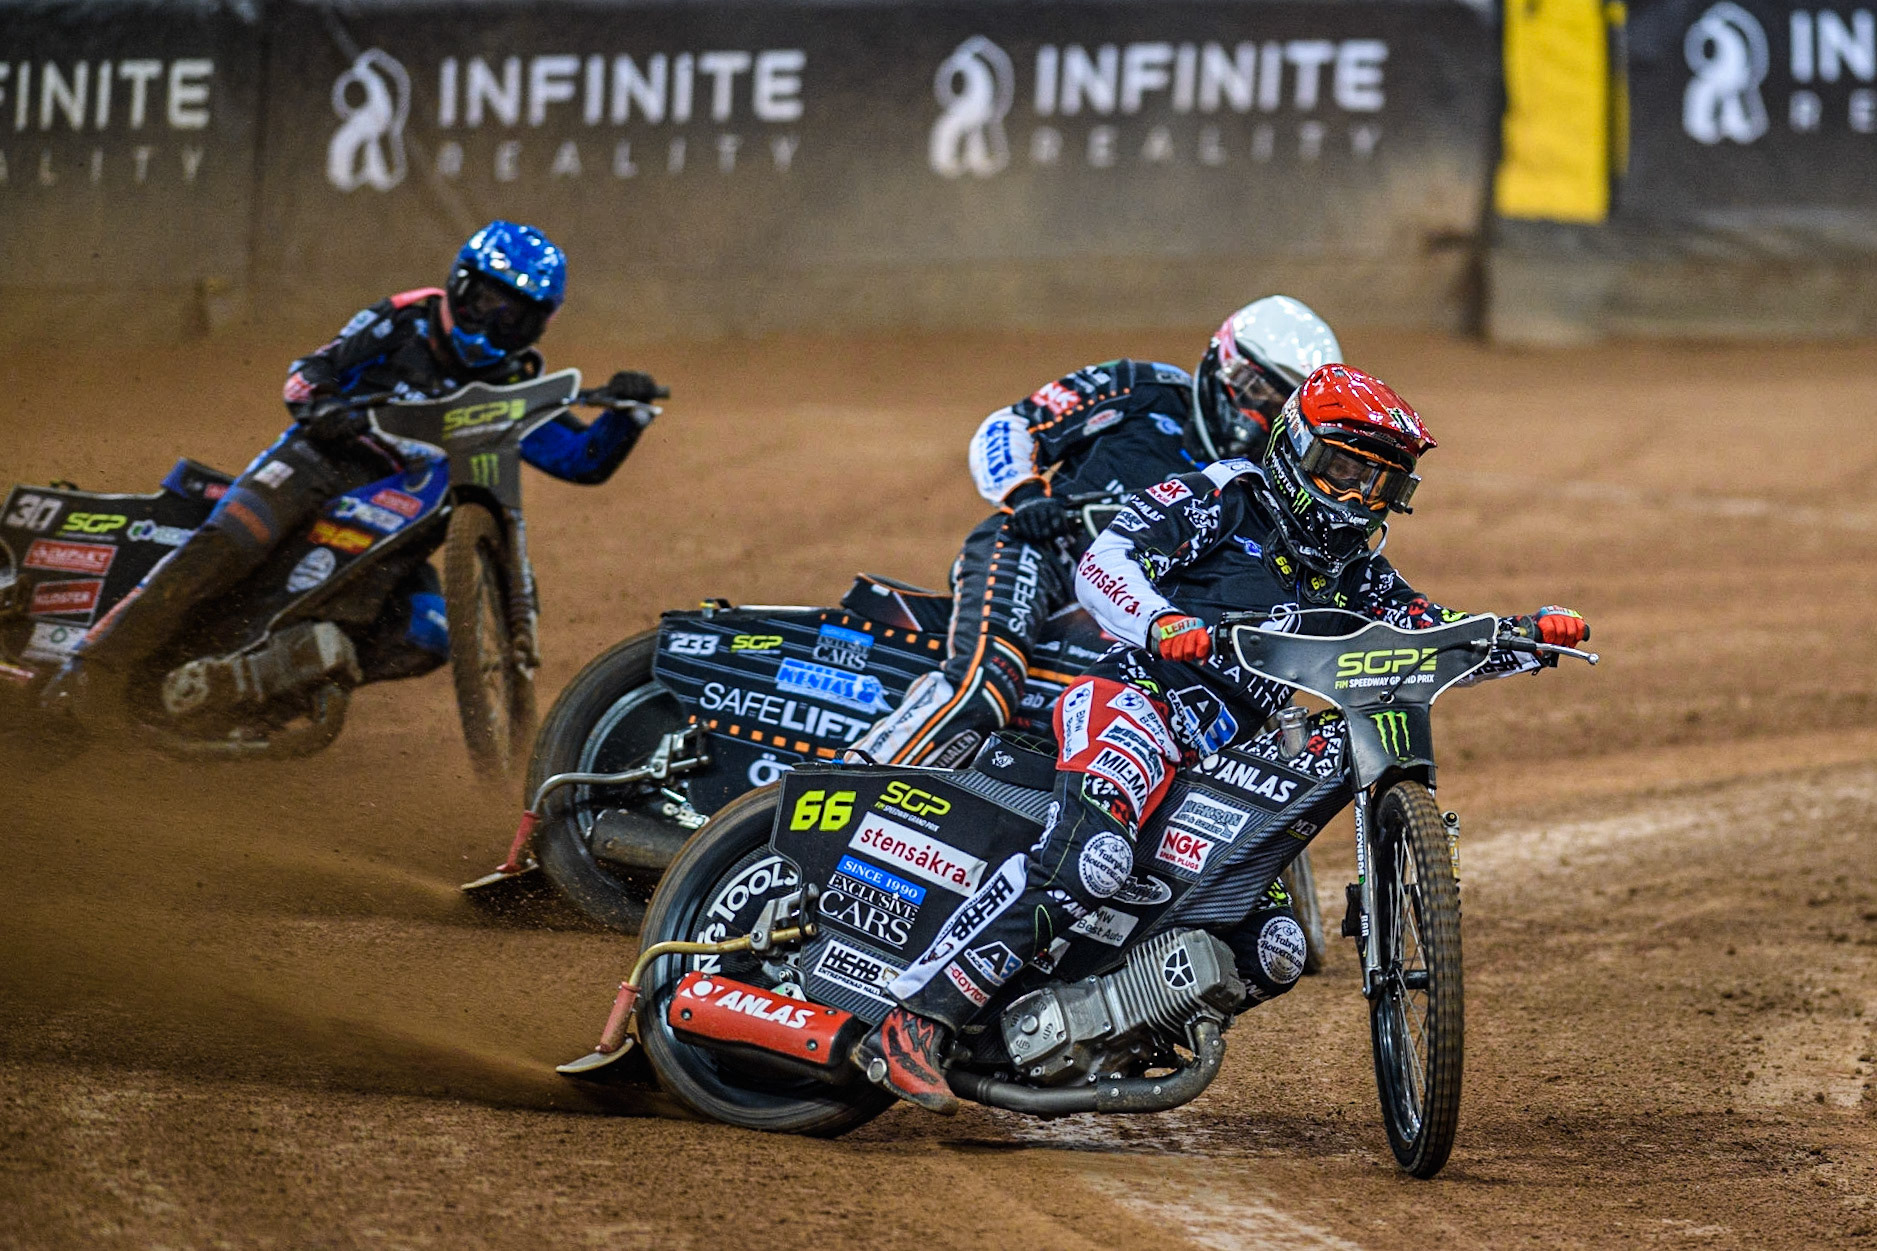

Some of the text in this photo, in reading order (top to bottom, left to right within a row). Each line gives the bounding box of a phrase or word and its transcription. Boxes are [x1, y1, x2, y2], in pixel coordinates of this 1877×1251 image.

[0, 57, 214, 131] INITE
[438, 50, 806, 128] INFINITE
[1033, 37, 1389, 116] INFINITE
[437, 135, 799, 181] REALITY
[1030, 121, 1381, 168] REALITY
[0, 147, 205, 186] LITY
[61, 512, 128, 533] SGP
[1275, 556, 1293, 575] 66
[1008, 544, 1043, 637] SAFELIFT
[668, 632, 722, 656] 233
[732, 635, 783, 650] SGP
[813, 645, 866, 670] CARS
[1336, 648, 1420, 677] SGP
[1349, 677, 1389, 688] SPEEDWAY
[1417, 674, 1435, 684] PRIX
[700, 682, 873, 742] SAFELIFT
[879, 781, 952, 816] SGP
[1213, 757, 1298, 803] ANLAS
[790, 790, 857, 831] 66
[1159, 850, 1199, 870] SPARK PLUGS
[1163, 829, 1208, 862] NGK
[706, 862, 799, 922] TOOLS
[829, 873, 919, 921] EXCLUSIVE
[843, 860, 919, 899] SINCE 1990
[819, 890, 912, 946] CARS
[1102, 926, 1124, 943] Auto
[822, 946, 882, 982] HERB
[714, 991, 816, 1030] ANLAS
